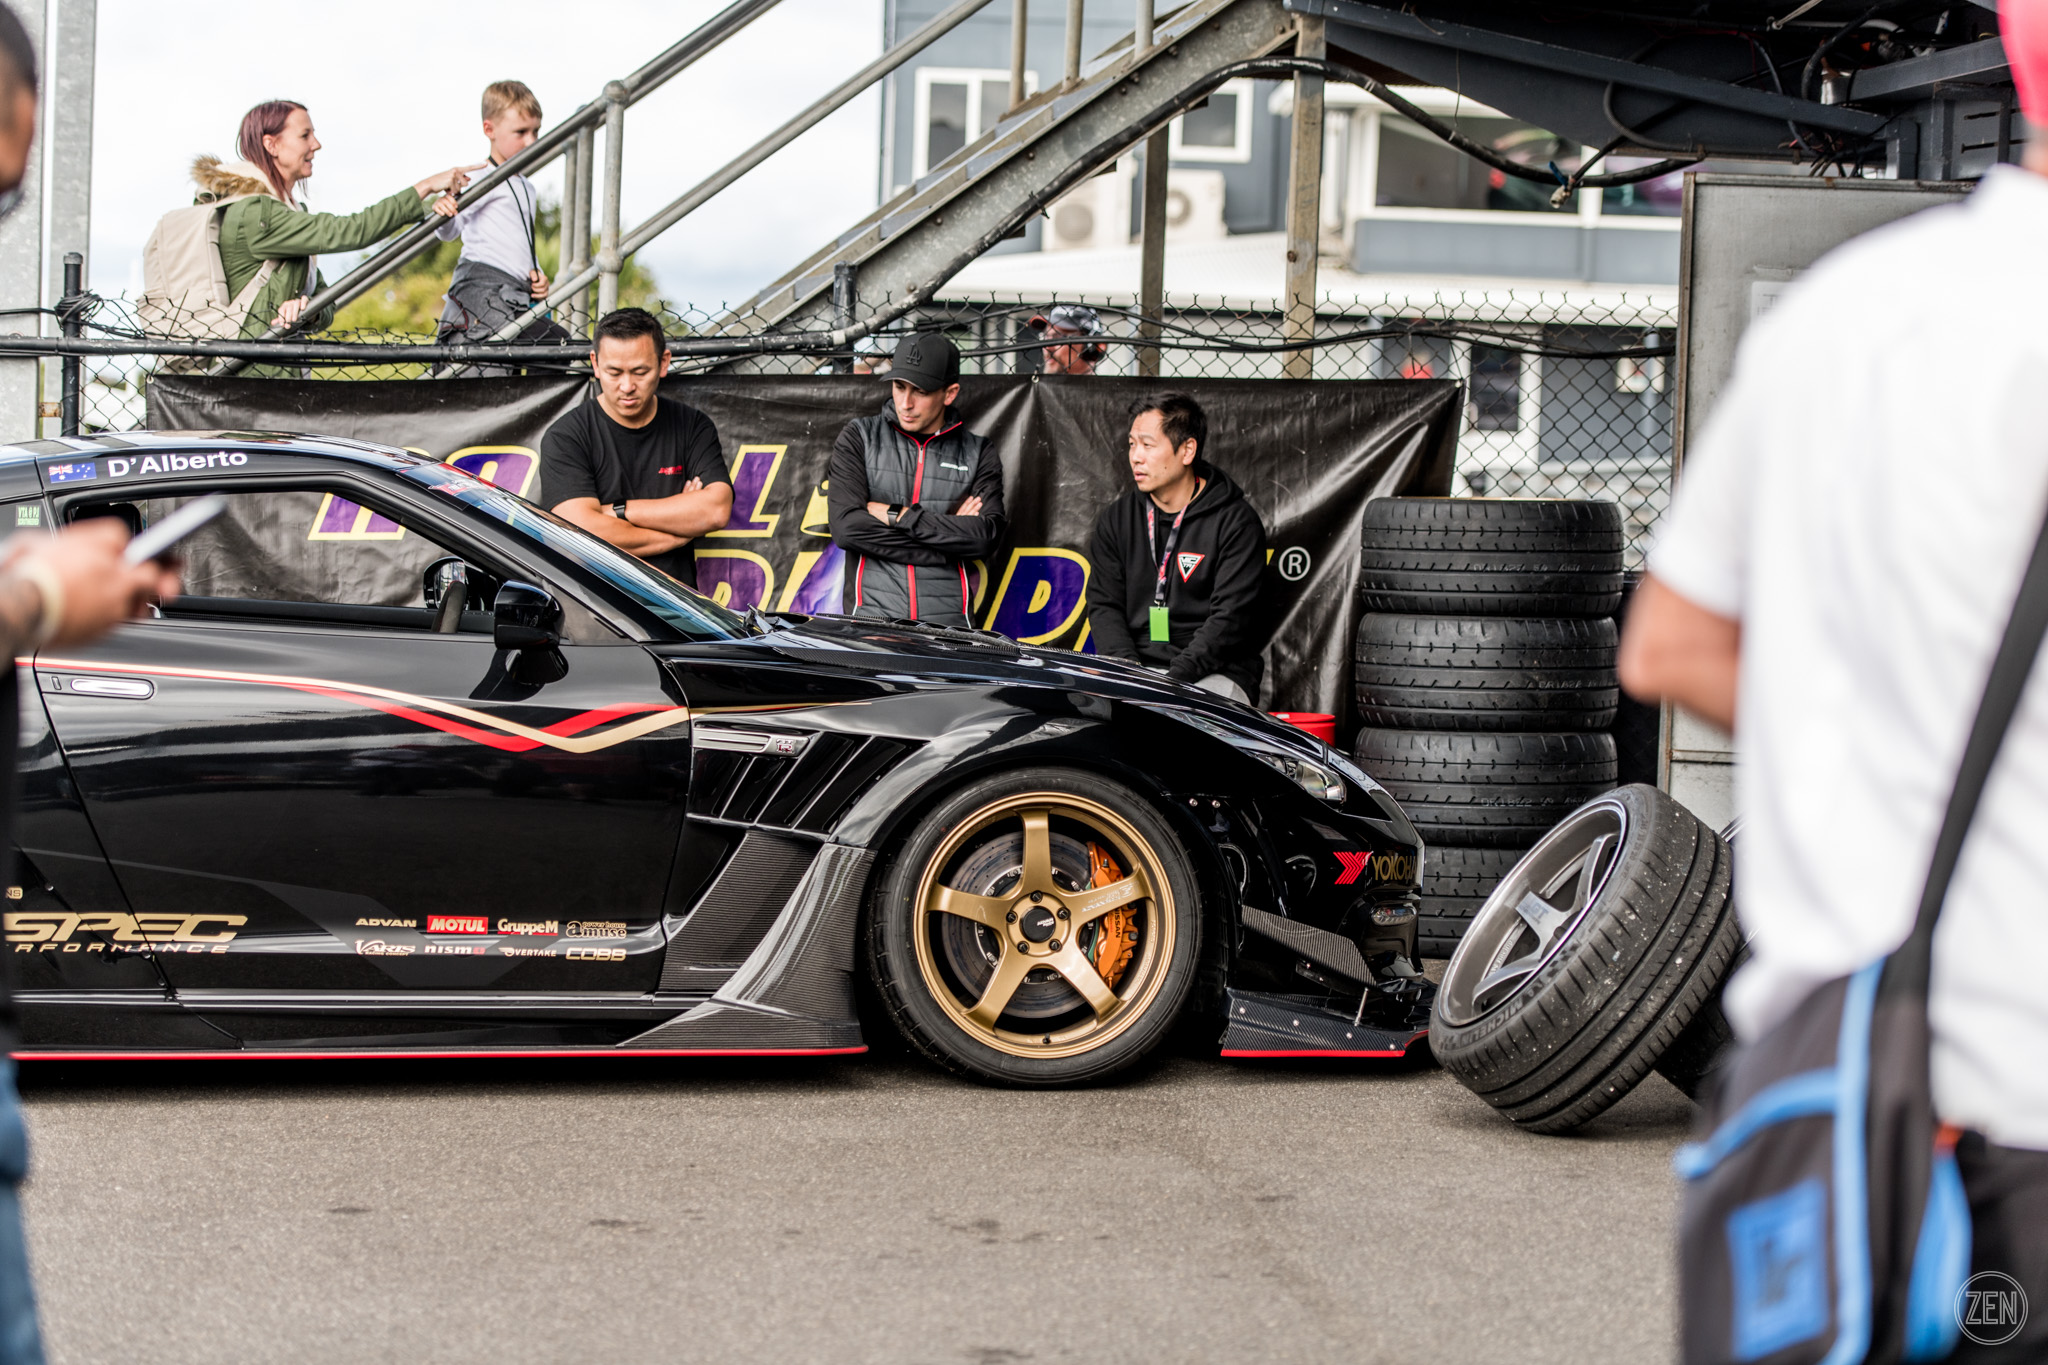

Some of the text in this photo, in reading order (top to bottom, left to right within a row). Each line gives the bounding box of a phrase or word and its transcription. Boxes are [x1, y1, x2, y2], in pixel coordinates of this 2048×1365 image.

[107, 451, 248, 477] D'Alberto
[356, 918, 417, 928] ADVAN
[429, 918, 486, 932] MOTUL
[497, 918, 558, 936] GruppeM
[14, 943, 230, 954] RFORMANCE
[424, 945, 486, 955] nismo
[565, 947, 627, 961] COBB
